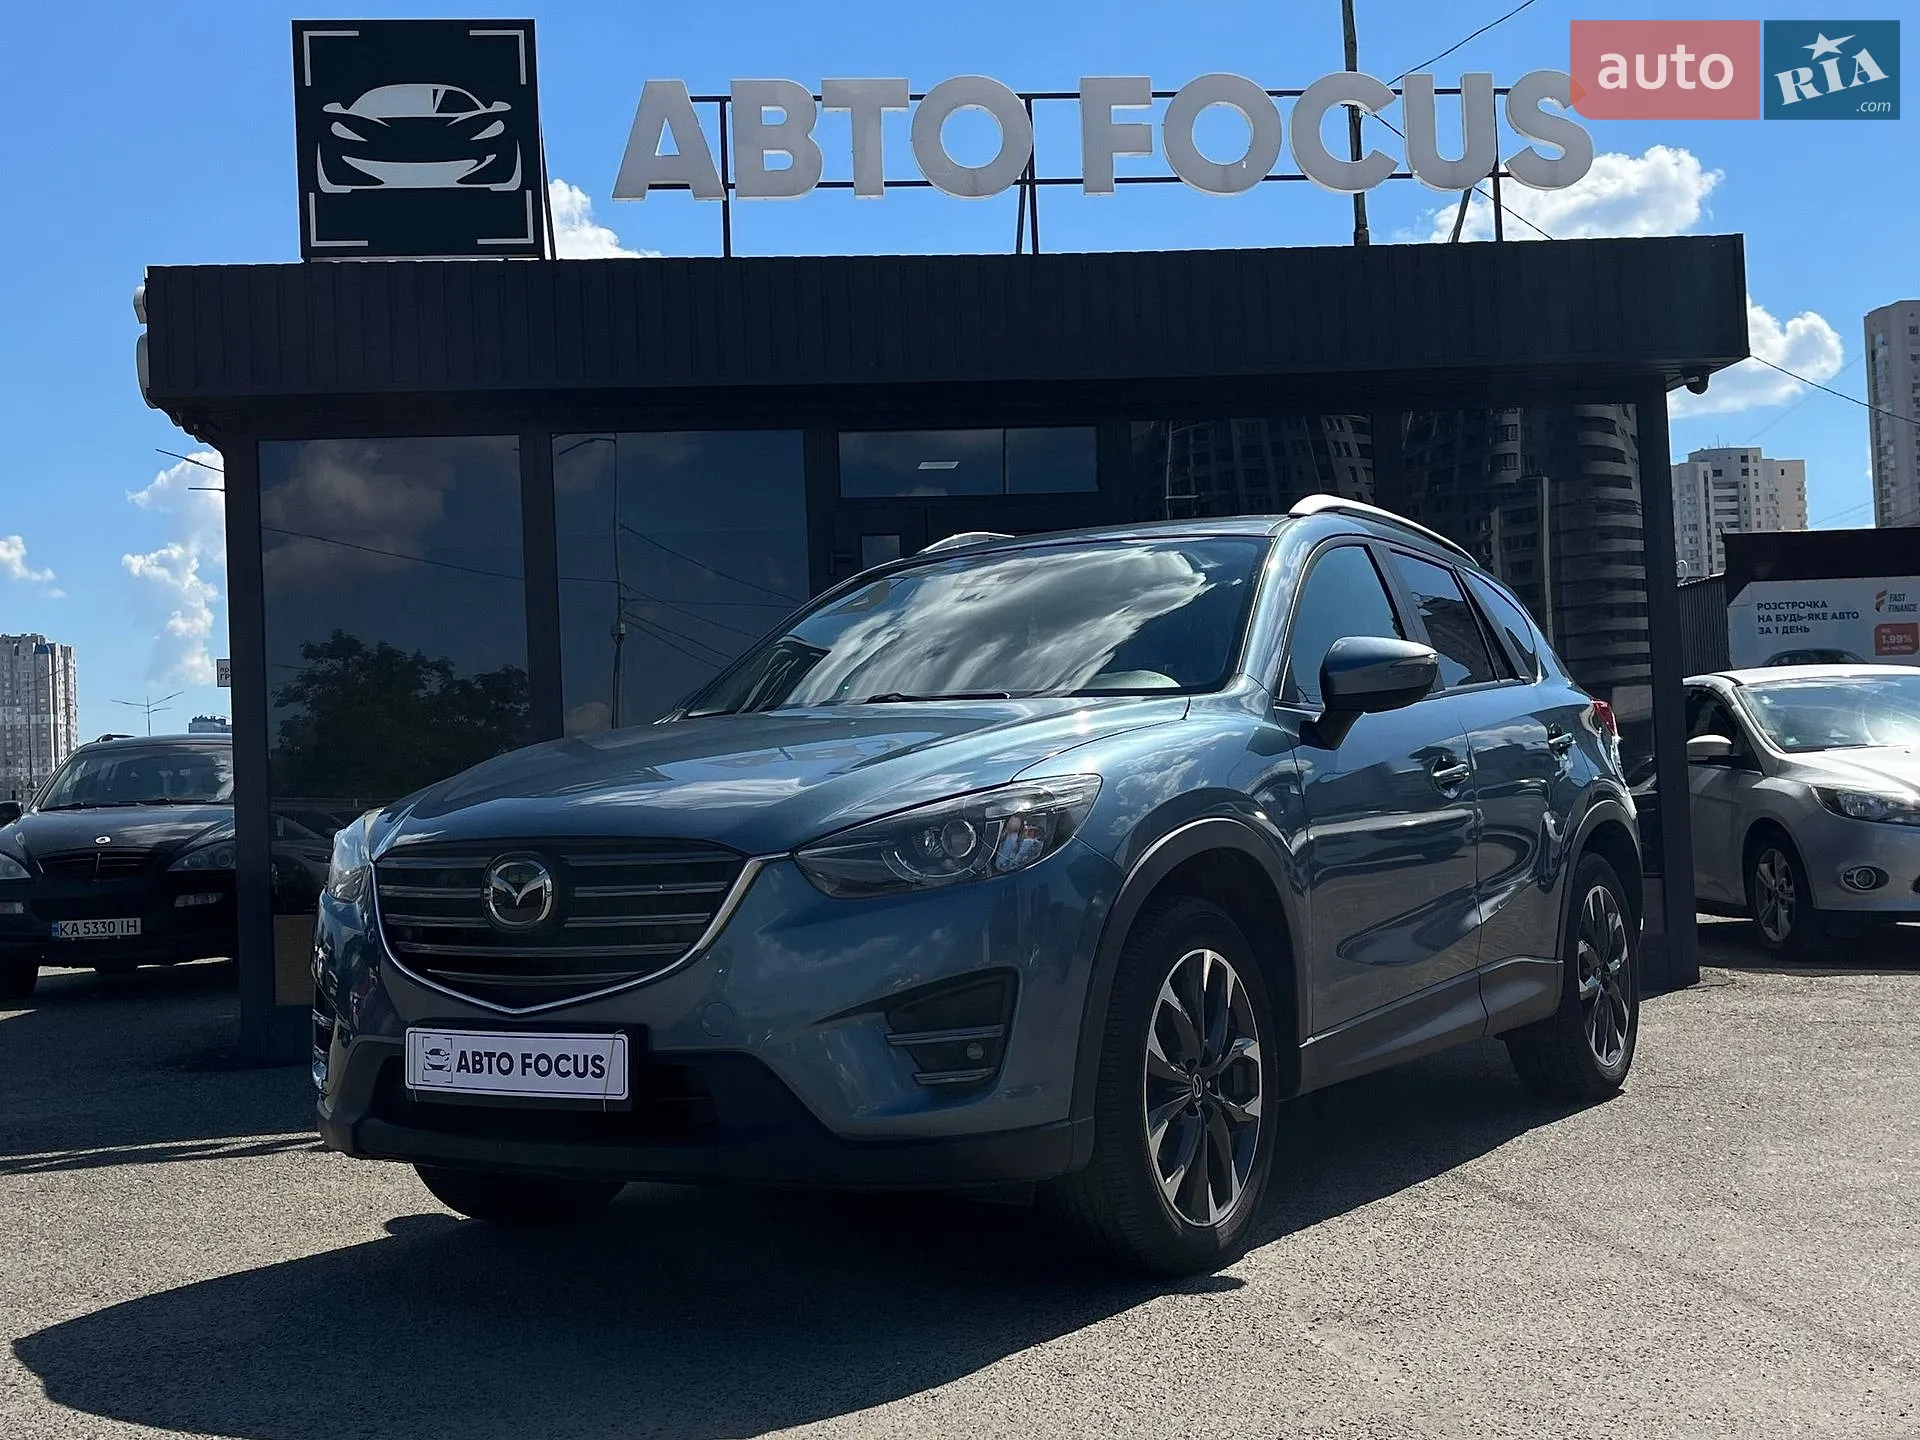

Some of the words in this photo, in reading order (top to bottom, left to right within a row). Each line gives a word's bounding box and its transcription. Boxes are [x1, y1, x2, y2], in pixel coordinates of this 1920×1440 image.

[612, 75, 1034, 201] АВТО
[1079, 70, 1595, 196] FOCUS
[1888, 592, 1907, 602] FAST
[1756, 600, 1828, 611] РОЗСТРОЧКА
[1757, 613, 1772, 623] НА
[1775, 612, 1829, 623] БУДЬ-ЯКЕ
[1831, 610, 1860, 621] АВТО
[1757, 625, 1773, 635] ЗА
[1781, 625, 1810, 636] ДЕНЬ
[59, 922, 79, 936] KA
[83, 921, 116, 935] 5330
[456, 1050, 514, 1076] АВТО
[520, 1052, 606, 1079] FOCUS
